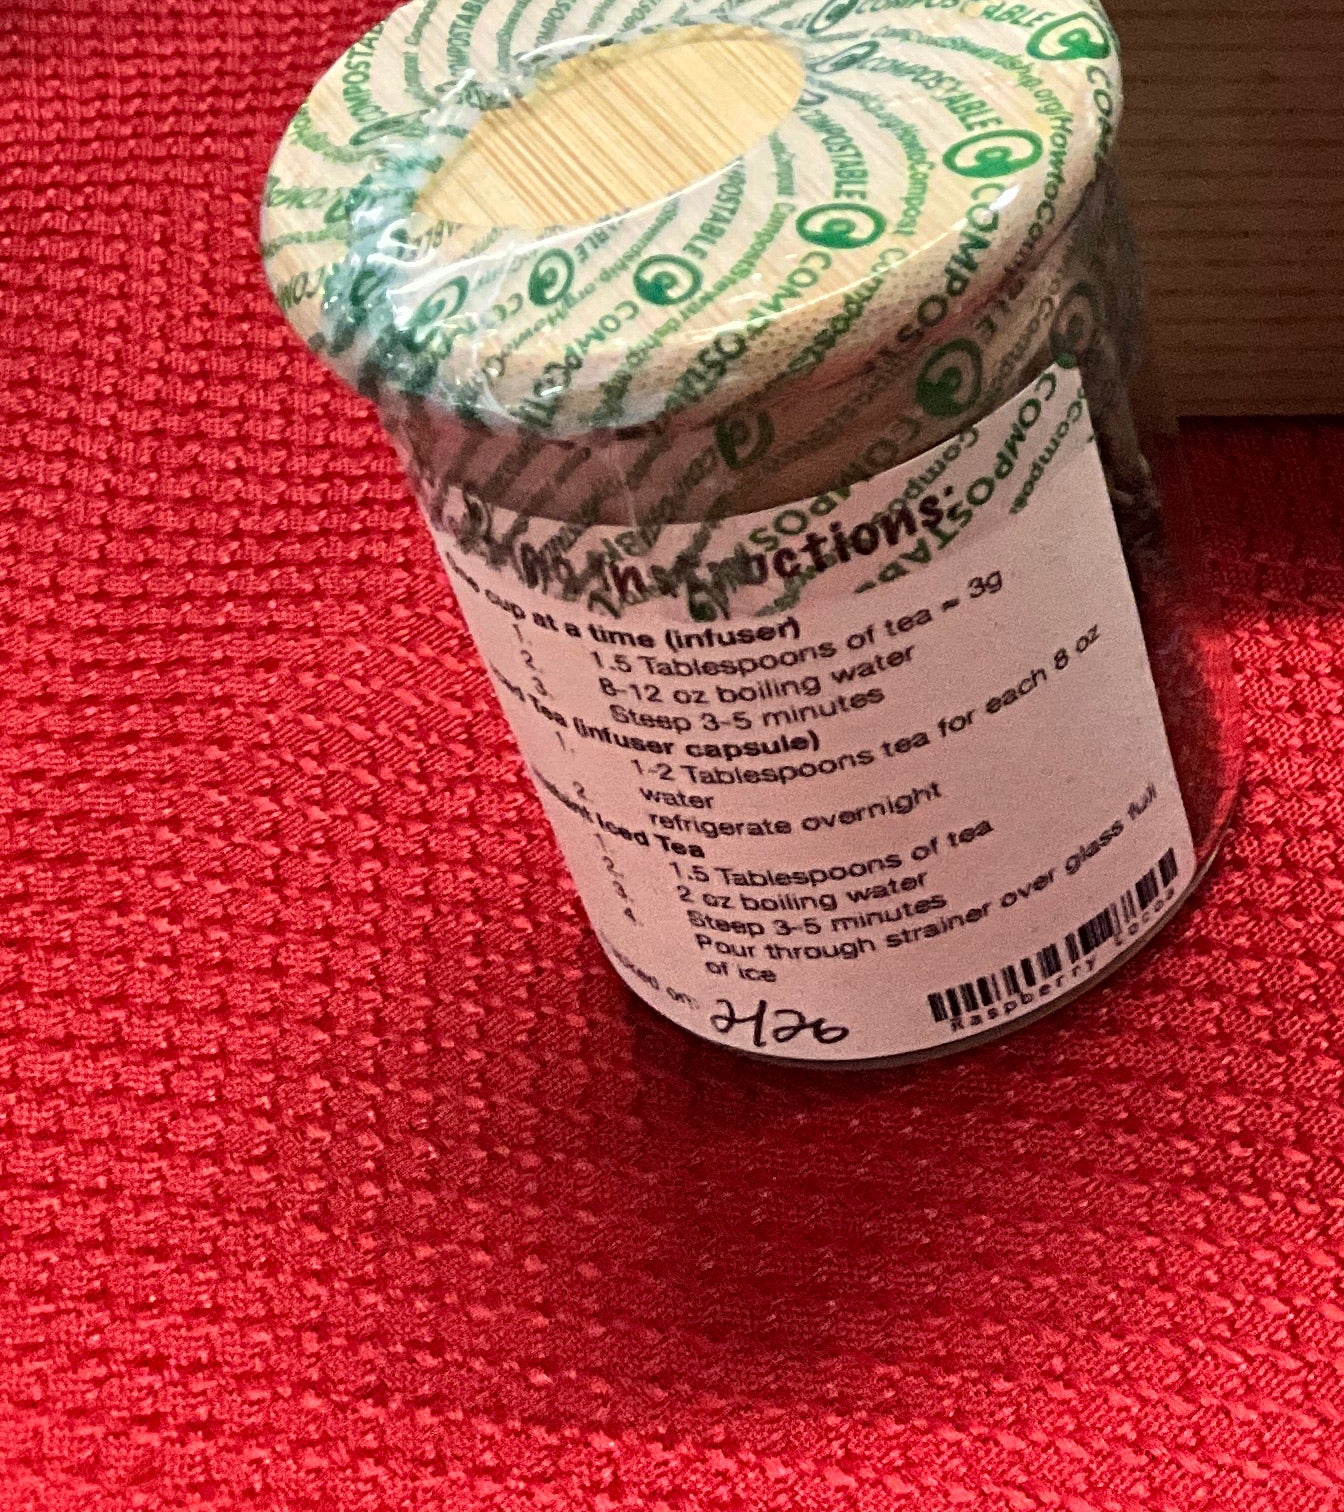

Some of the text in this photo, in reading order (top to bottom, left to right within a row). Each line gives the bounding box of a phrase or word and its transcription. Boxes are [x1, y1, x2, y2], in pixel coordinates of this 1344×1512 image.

[588, 615, 801, 653] time (infuser)
[591, 607, 933, 675] 1.5 Tablespoons of tea
[673, 643, 915, 706] oz boiling water
[610, 687, 886, 734] Steep 3-5 minutes
[680, 648, 1070, 786] Tablespoons tea for each 8
[685, 730, 820, 761] capsule)
[639, 787, 714, 809] water
[649, 781, 942, 839] refrigerate overnight
[654, 834, 705, 858] Tea
[714, 820, 994, 888] Tablespoons of tea
[702, 870, 928, 912] oz boiling water
[687, 895, 947, 937] Steep 3-5 minutes
[696, 868, 1056, 960] Pour through strainer over
[706, 961, 776, 983] of ice
